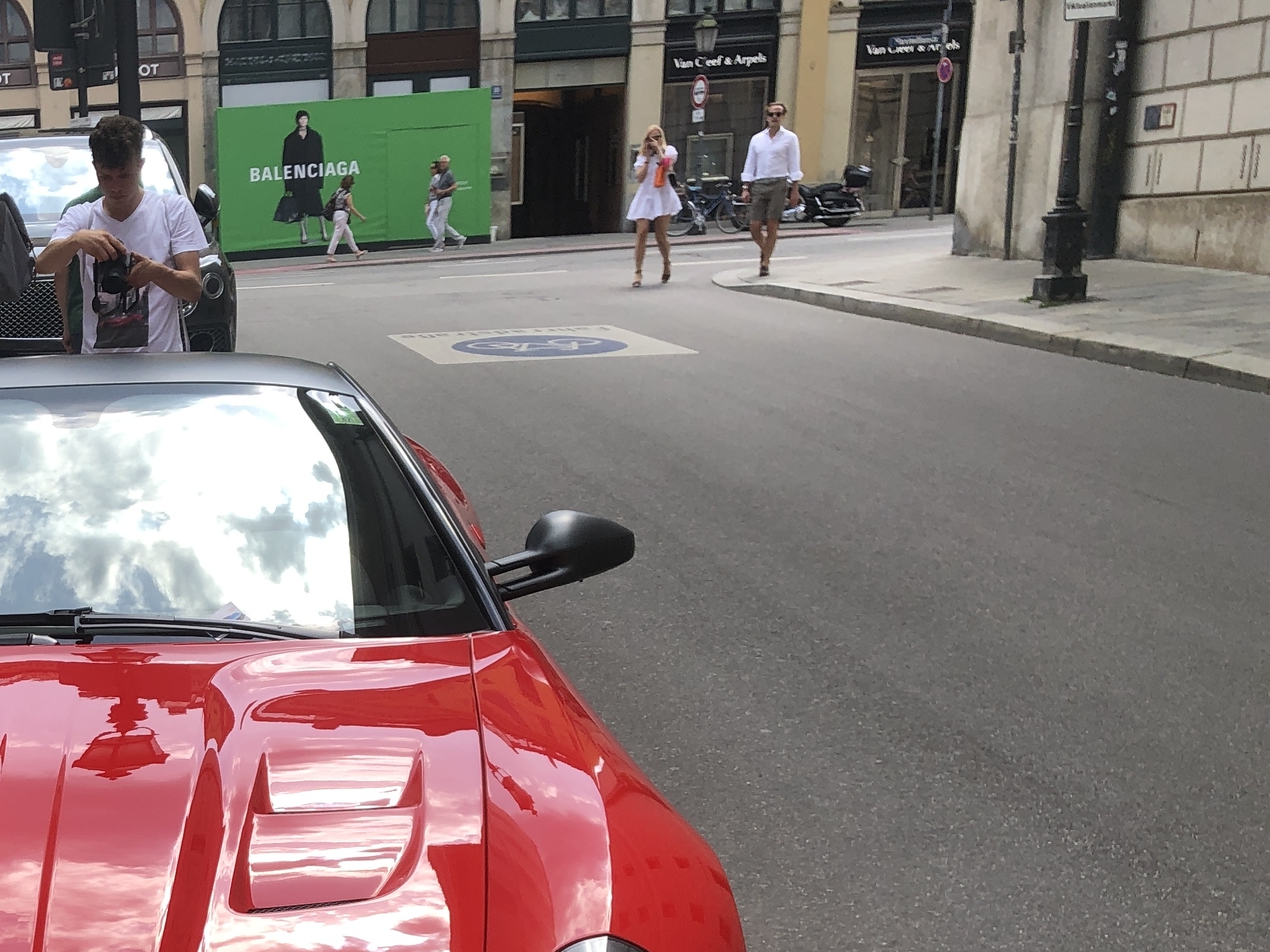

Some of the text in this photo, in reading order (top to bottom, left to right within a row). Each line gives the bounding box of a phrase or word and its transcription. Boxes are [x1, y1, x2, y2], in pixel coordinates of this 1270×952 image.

[866, 44, 886, 55] Van
[927, 39, 961, 54] Arels
[674, 52, 768, 69] Van Ceef & Arpels
[250, 161, 360, 182] BALENCIAGA
